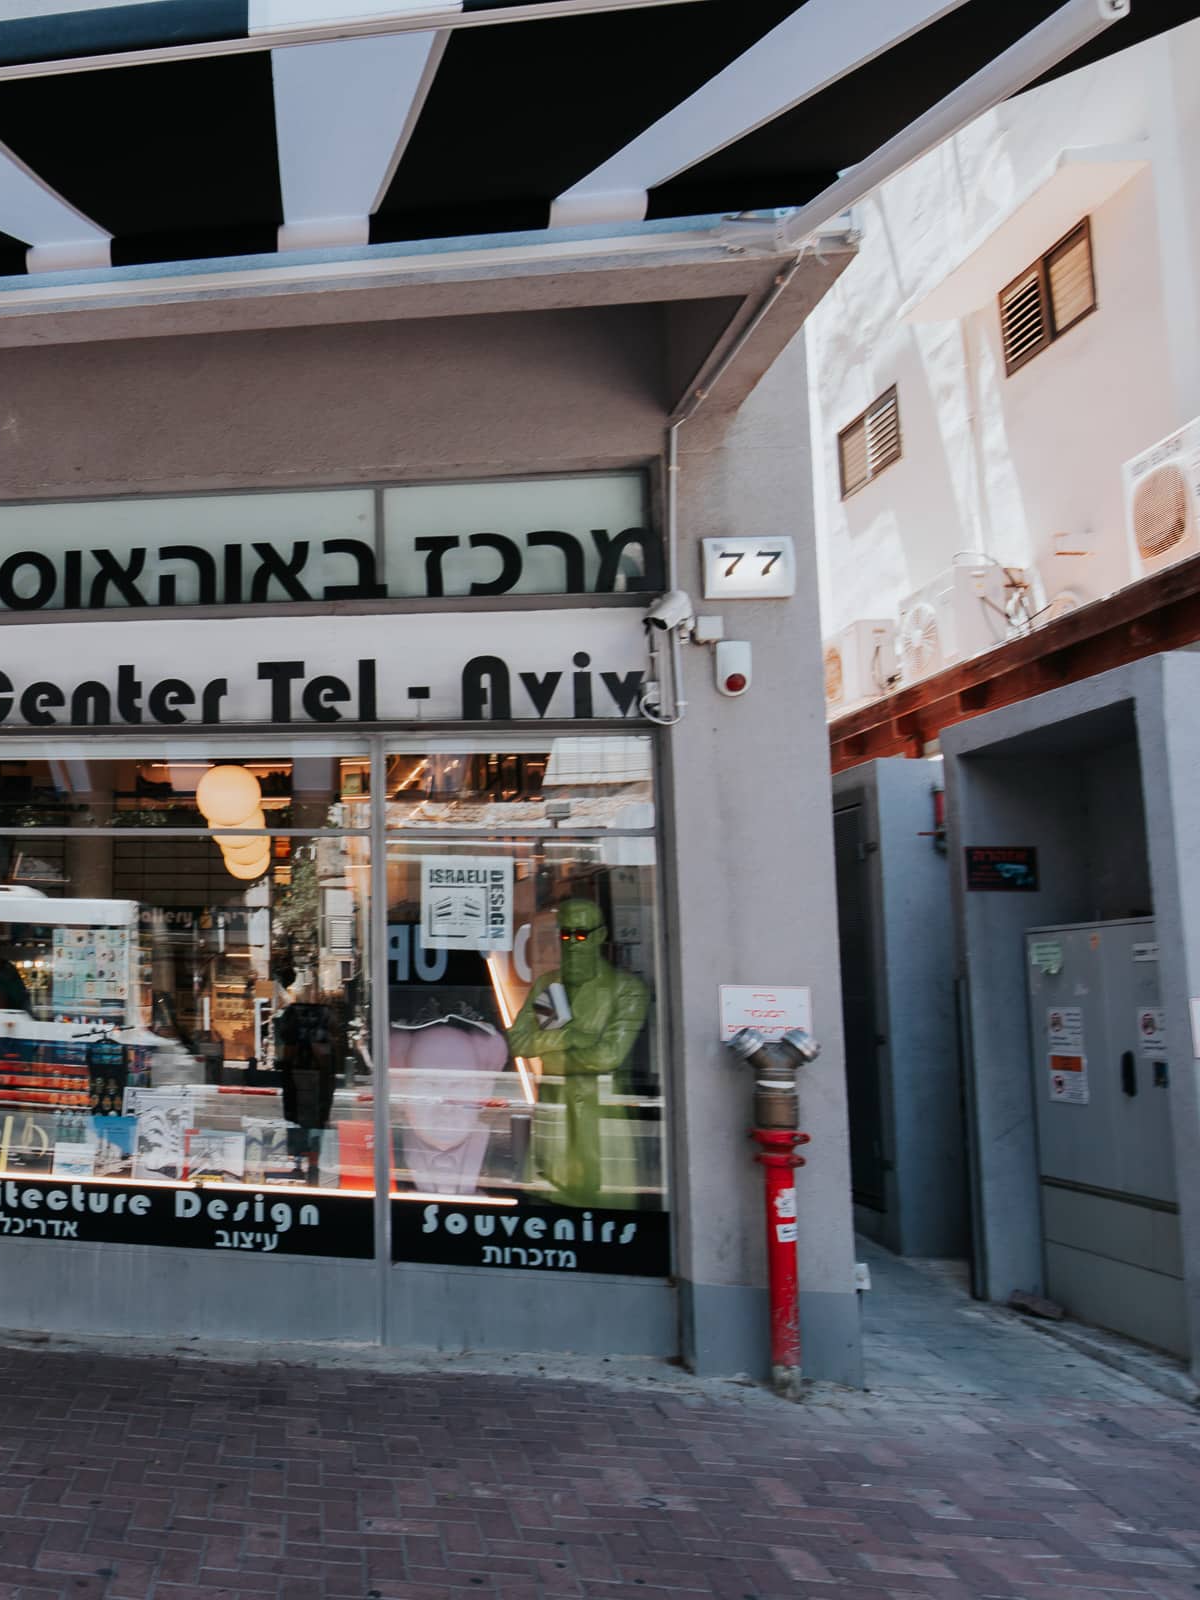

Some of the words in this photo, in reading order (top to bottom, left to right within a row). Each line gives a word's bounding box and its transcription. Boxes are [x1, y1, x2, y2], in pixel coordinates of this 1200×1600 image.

[414, 528, 665, 597] מרכז
[719, 551, 783, 577] 77
[257, 659, 377, 723] Tel
[462, 651, 646, 720] Aviv
[429, 868, 487, 884] ISRAELI
[490, 870, 505, 939] DESIGN
[175, 1191, 320, 1233] Design
[422, 1204, 638, 1244] Souvenirs
[215, 1230, 279, 1251] עיצוב
[482, 1245, 577, 1268] מזכרות
